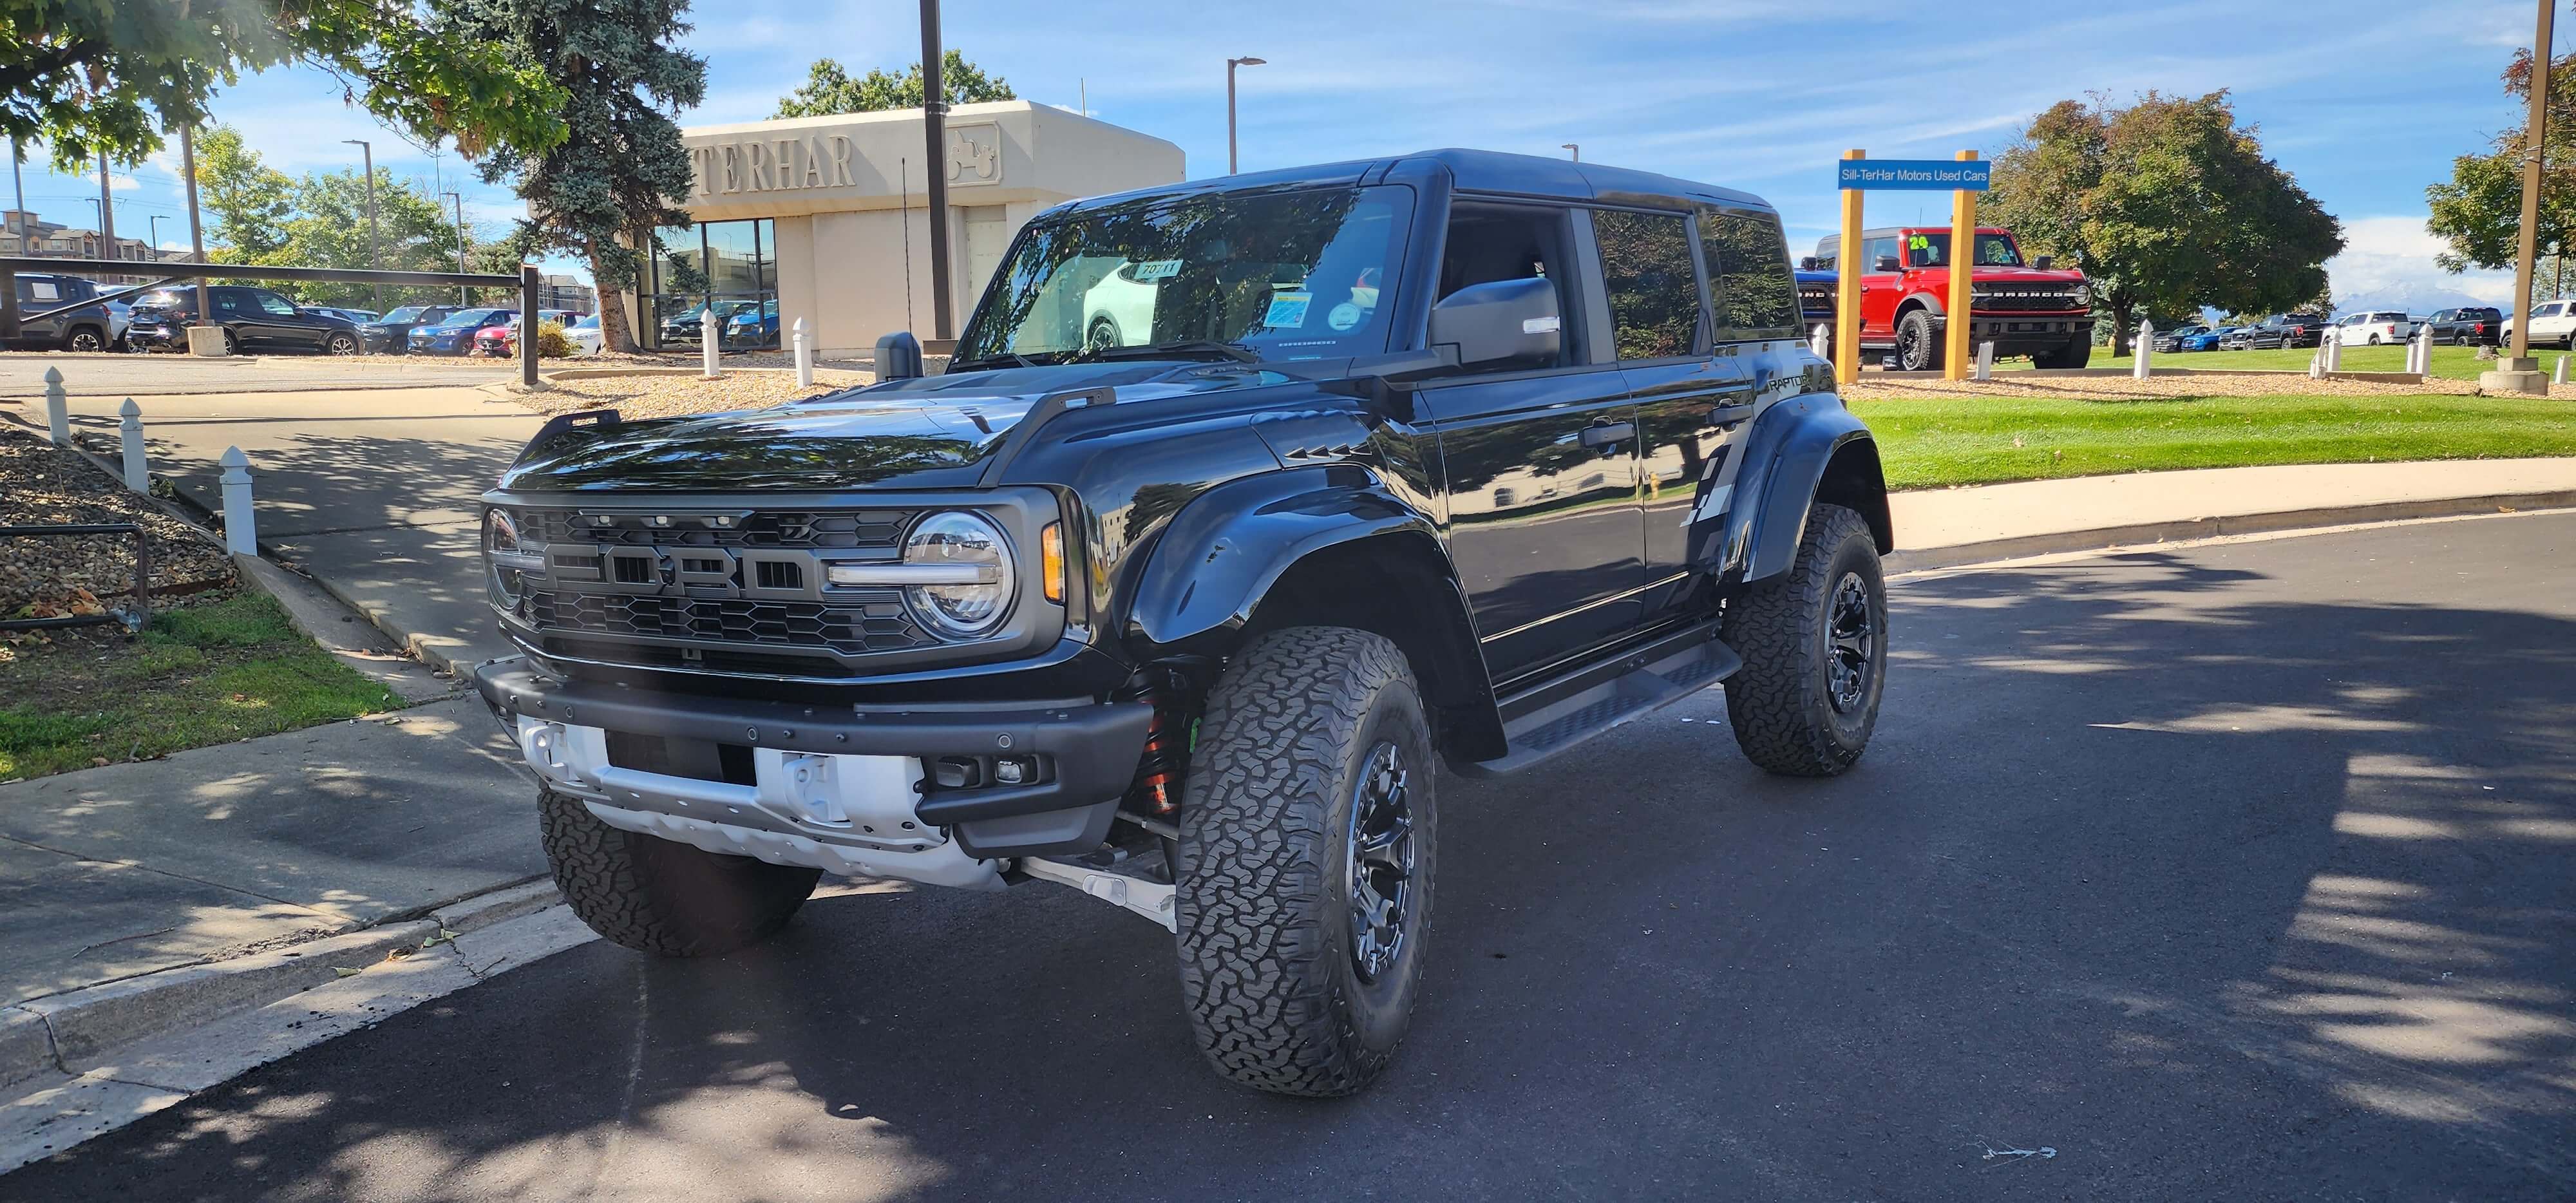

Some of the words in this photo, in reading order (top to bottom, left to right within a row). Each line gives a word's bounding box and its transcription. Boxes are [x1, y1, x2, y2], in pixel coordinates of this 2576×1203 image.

[693, 136, 856, 195] TERHAR
[1842, 169, 1895, 180] Sill-TerHar
[1897, 170, 1932, 181] Motors
[1934, 170, 1960, 181] Used
[1963, 170, 1987, 181] Cars
[1767, 374, 1814, 393] RAPTOR
[544, 543, 821, 601] FORD
